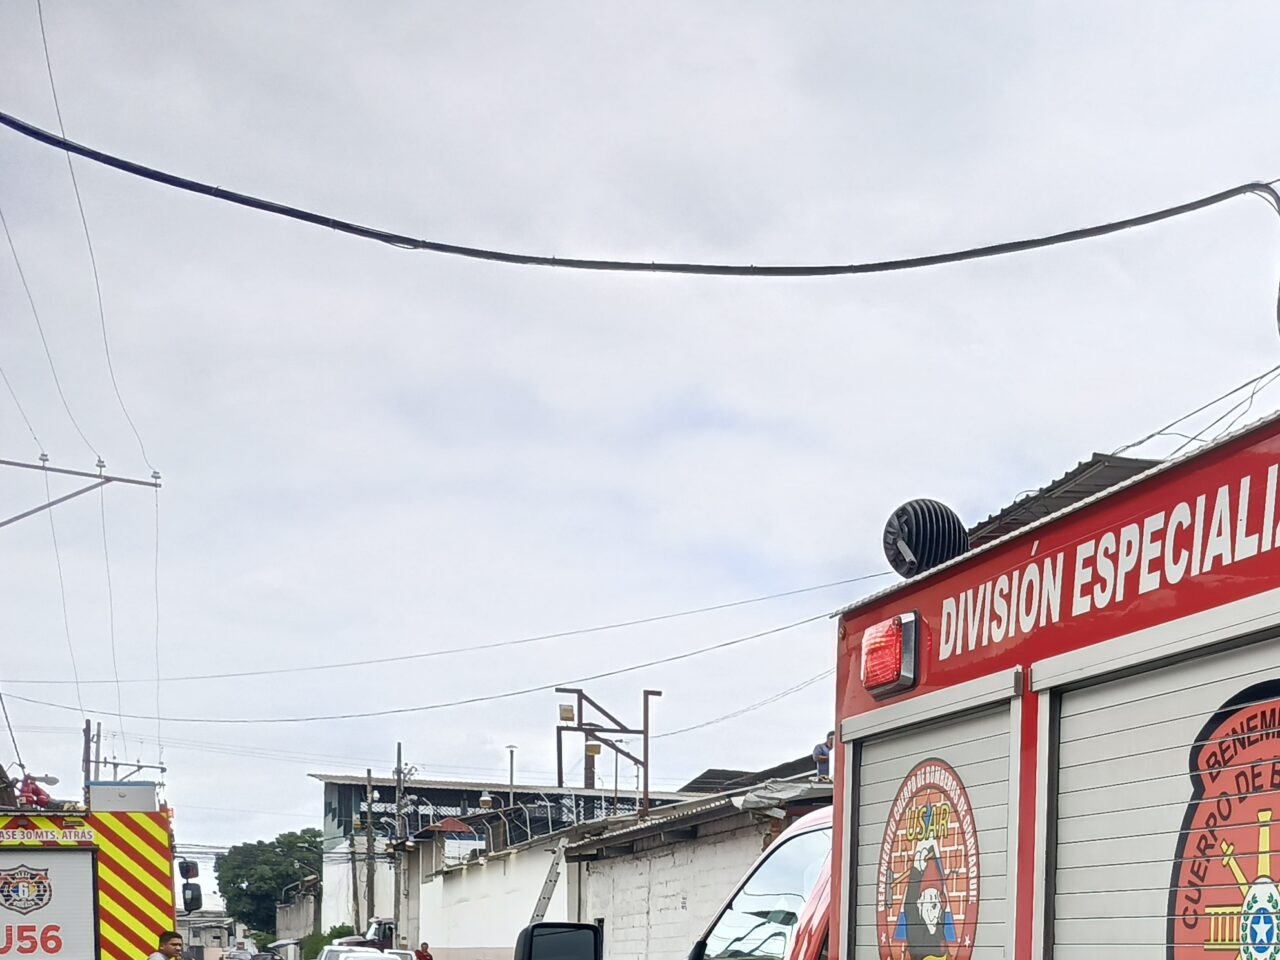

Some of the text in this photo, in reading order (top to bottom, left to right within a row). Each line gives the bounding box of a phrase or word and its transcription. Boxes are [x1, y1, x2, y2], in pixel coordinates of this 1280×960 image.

[939, 540, 1064, 661] DIVISIÓN
[894, 776, 916, 820] CUERPO
[20, 830, 32, 840] 30
[35, 830, 59, 840] MTS.
[62, 828, 93, 840] ATRÁS
[905, 803, 951, 841] USAR
[1182, 791, 1232, 929] CUERPO
[1235, 758, 1264, 804] DE
[0, 925, 63, 954] U56
